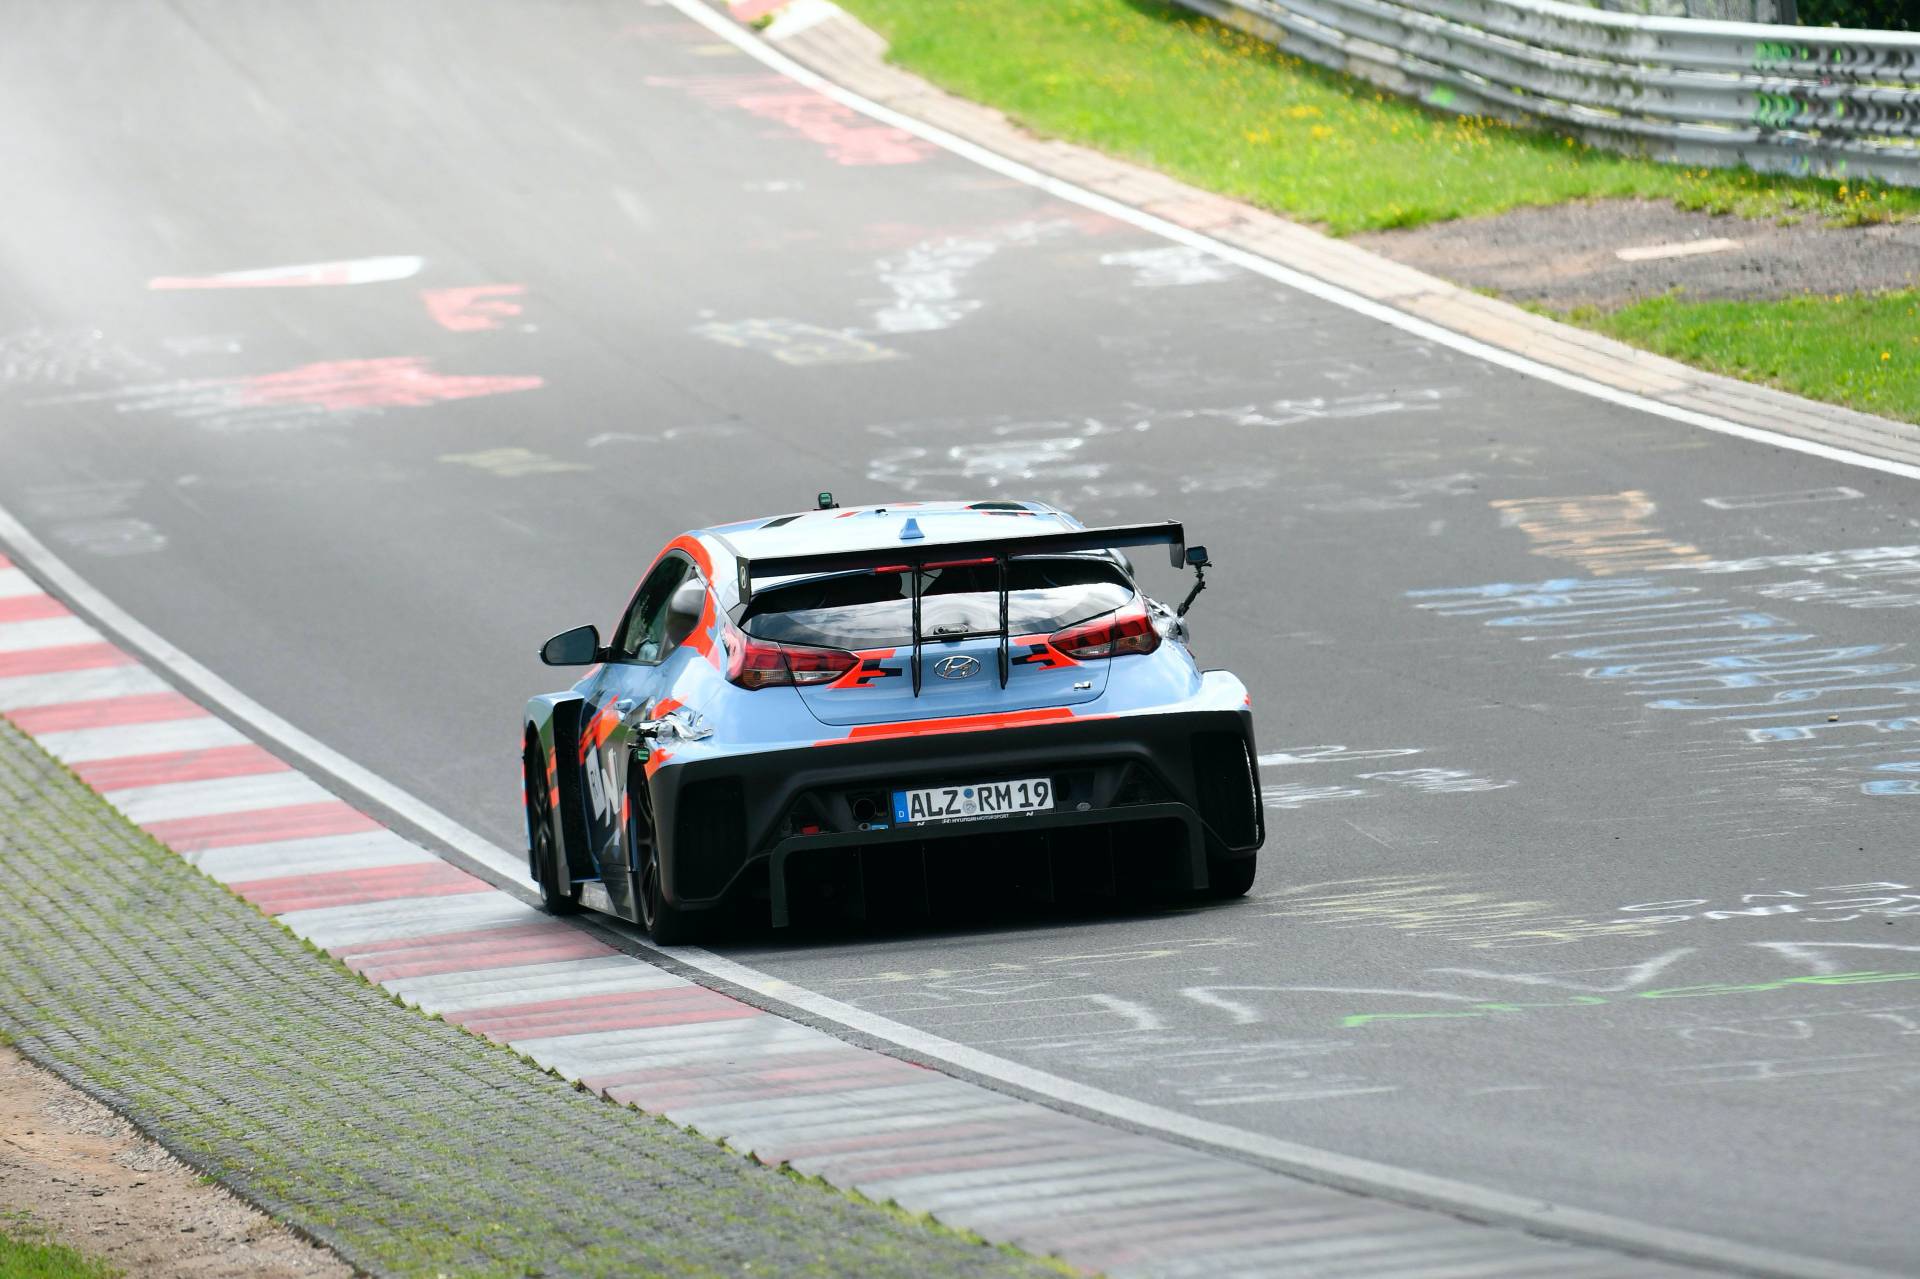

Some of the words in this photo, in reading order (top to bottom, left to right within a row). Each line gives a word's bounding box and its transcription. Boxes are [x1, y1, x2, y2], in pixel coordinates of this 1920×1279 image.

[910, 789, 962, 819] ALZ
[977, 784, 1013, 812] RM
[1017, 781, 1049, 808] 19
